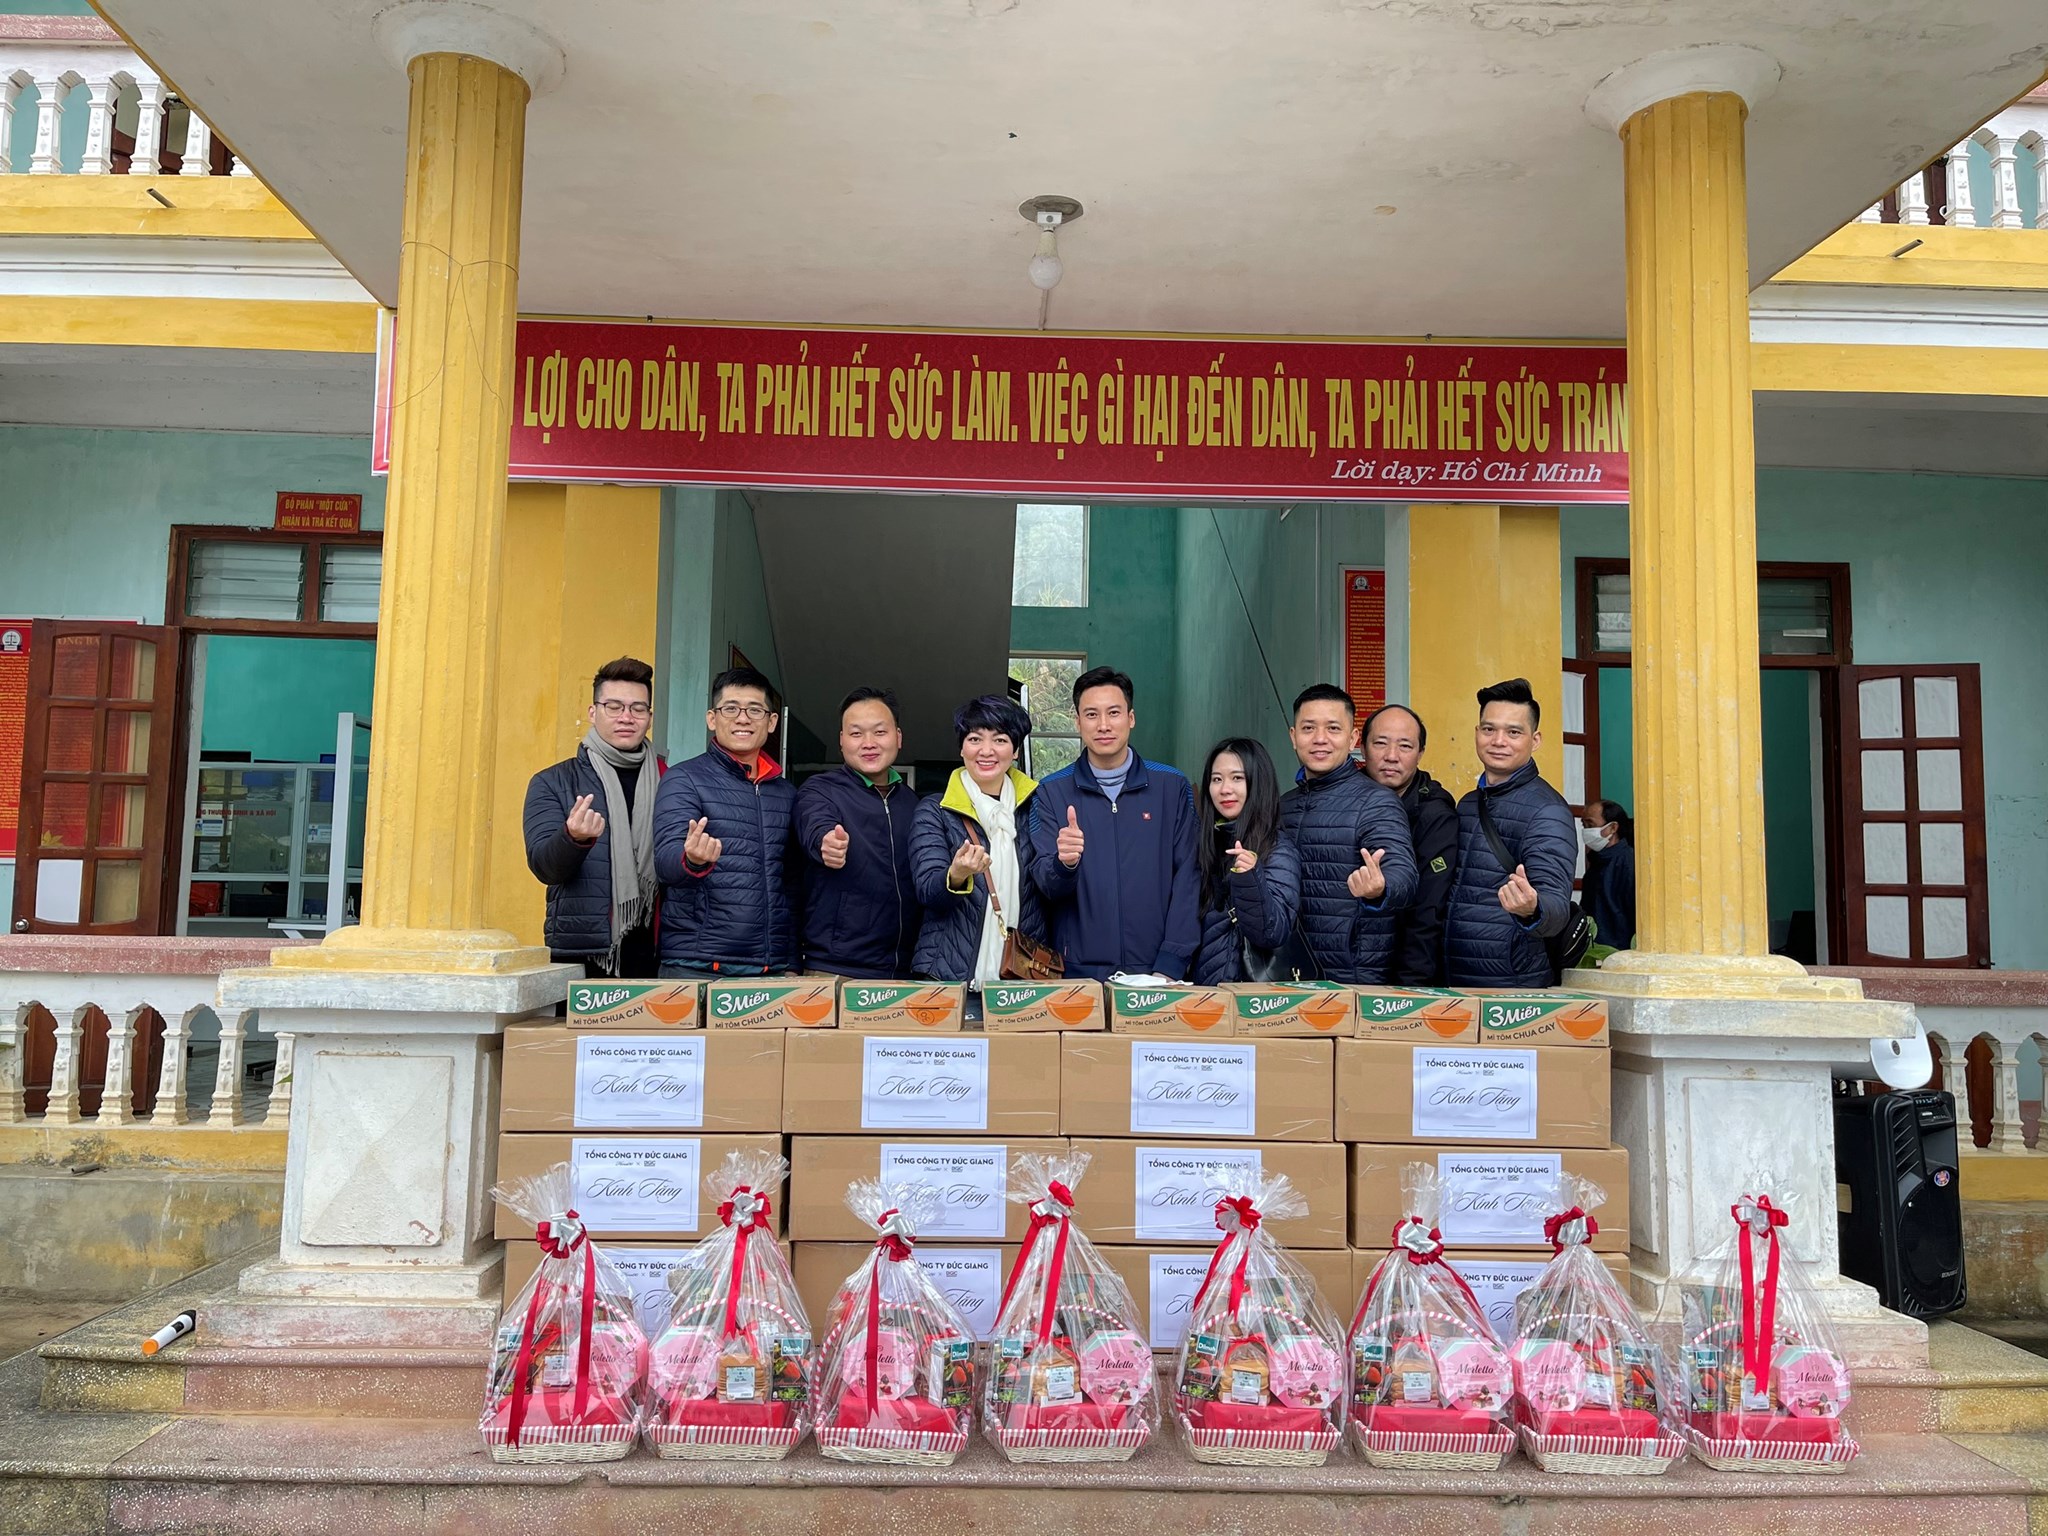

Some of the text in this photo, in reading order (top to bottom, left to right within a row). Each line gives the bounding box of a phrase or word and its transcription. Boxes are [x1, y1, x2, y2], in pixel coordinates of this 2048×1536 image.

[523, 350, 567, 444] LỢI
[576, 357, 630, 430] CHO
[641, 345, 706, 441] DÂN,
[717, 362, 746, 433] TA
[754, 340, 821, 436] PHẢI
[829, 343, 880, 437] HẾT
[888, 353, 943, 440] SỨC
[951, 355, 1018, 442] LÀM.
[1028, 357, 1088, 460] VIỆC
[1099, 358, 1125, 445] GÌ
[1133, 375, 1179, 462] HẠI
[1187, 353, 1242, 447] ĐẾN
[1252, 362, 1316, 458] DÂN,
[1325, 379, 1356, 449] TA
[1364, 355, 1428, 452] PHẢI
[1437, 358, 1486, 452] HẾT
[1496, 367, 1550, 453] SỨC
[1331, 457, 1602, 484] Lời dạy: Hồ Chí Minh
[301, 515, 310, 527] VÀ
[312, 512, 324, 527] TRẢ
[325, 514, 338, 528] KẾT
[600, 1012, 625, 1024] CHUA
[626, 1005, 644, 1018] CAY
[741, 1015, 766, 1028] CHUA
[766, 1007, 784, 1020] CAY
[873, 1010, 905, 1022] CHUA CAY
[1016, 1010, 1048, 1023] CHUA CAY
[1144, 1014, 1177, 1026] CHUA CAY
[1266, 1015, 1299, 1028] CHUA CAY
[1390, 1021, 1423, 1032] CHUA CAY
[1513, 1027, 1538, 1040] CHUA
[1538, 1022, 1556, 1035] CAY
[614, 1048, 636, 1056] CÔNG
[649, 1048, 666, 1056] ĐỨC
[899, 1049, 922, 1057] CÔNG
[934, 1049, 950, 1058] ĐỨC
[1167, 1055, 1189, 1063] CÔNG
[1201, 1055, 1218, 1064] ĐỨC
[1219, 1057, 1243, 1065] GIANG
[1448, 1060, 1471, 1068] CÔNG
[1483, 1060, 1499, 1069] ĐỨC
[608, 1151, 631, 1159] CÔNG
[644, 1151, 661, 1159] ĐỨC
[952, 1156, 968, 1165] ĐỨC
[1171, 1160, 1194, 1168] CÔNG
[1508, 1165, 1524, 1173] ĐỨC
[614, 1261, 637, 1269] CÔNG
[650, 1261, 666, 1269] ĐỨC
[947, 1261, 962, 1269] ĐỨC
[1493, 1273, 1509, 1282] ĐỨC
[1096, 1359, 1134, 1370] Merletto
[1455, 1364, 1494, 1375] Merletto
[1795, 1372, 1833, 1383] Merletto
